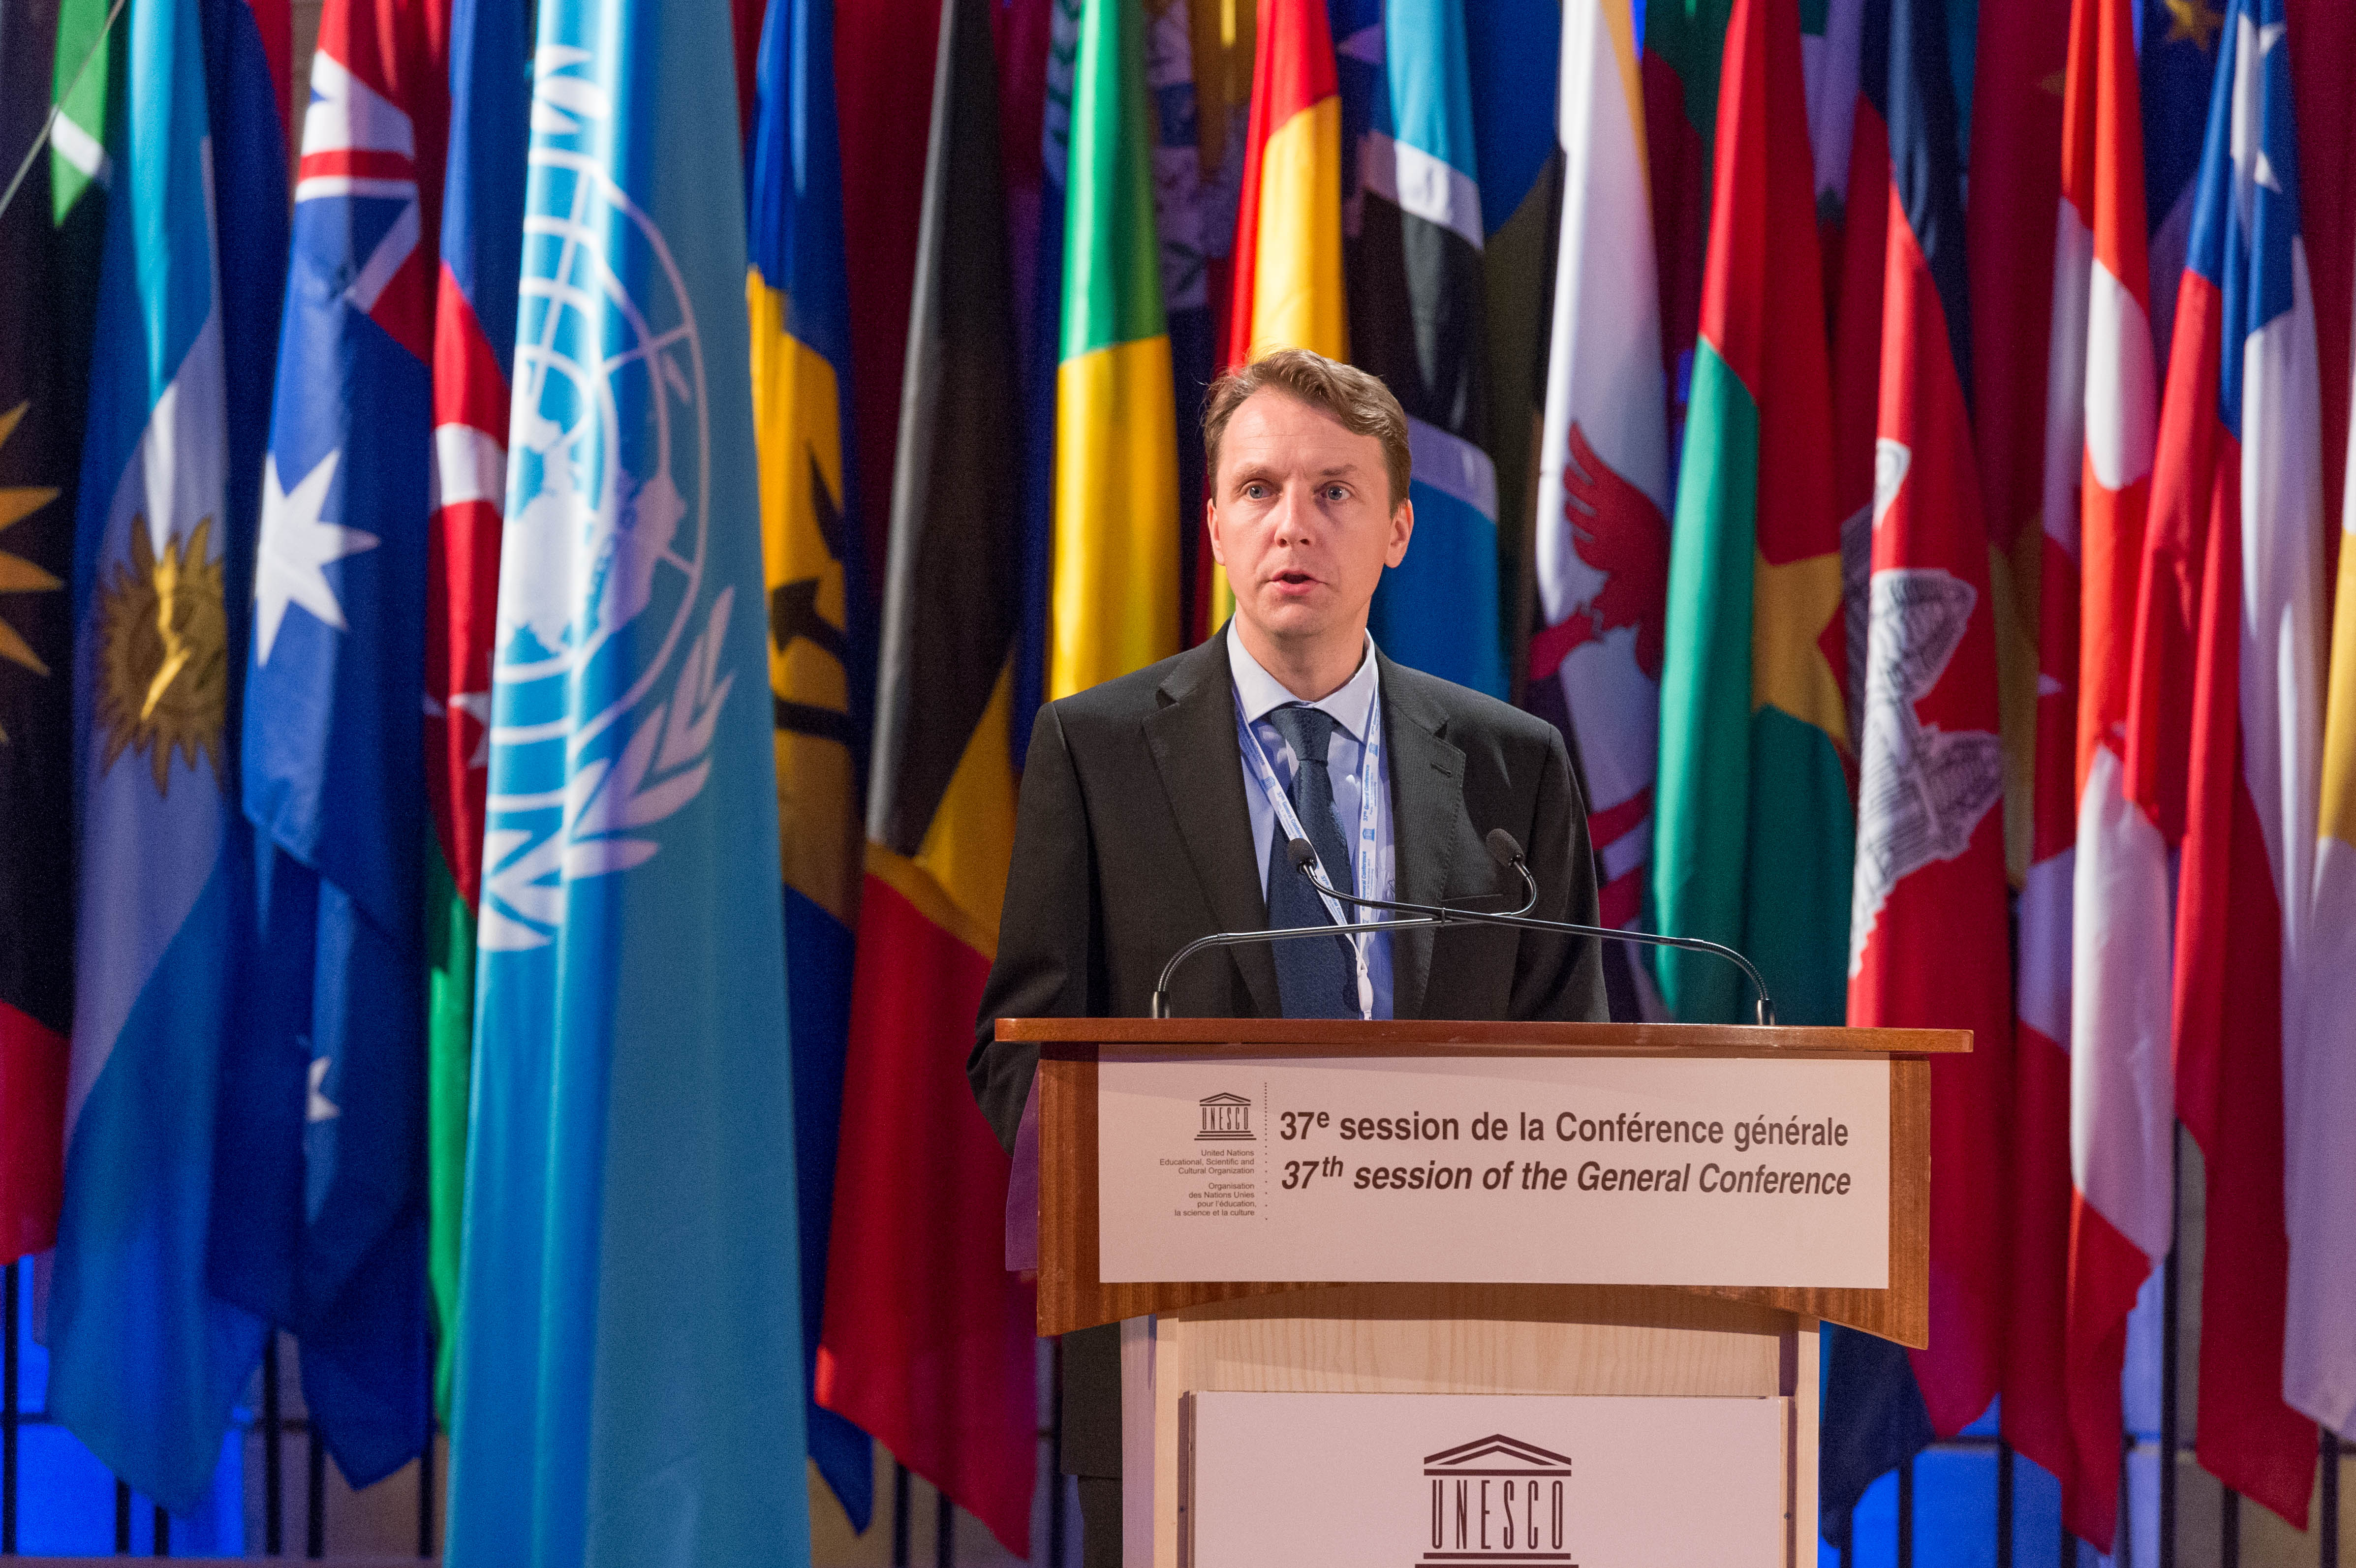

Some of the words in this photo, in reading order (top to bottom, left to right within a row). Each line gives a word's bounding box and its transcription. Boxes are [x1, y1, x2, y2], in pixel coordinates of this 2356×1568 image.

[1202, 1107, 1248, 1130] UNESCO
[1280, 1111, 1330, 1140] 37e
[1339, 1111, 1459, 1140] session
[1471, 1111, 1508, 1140] de
[1520, 1111, 1545, 1141] la
[1556, 1112, 1724, 1144] Conférence
[1734, 1114, 1849, 1152] générale
[1208, 1167, 1254, 1175] Organization
[1281, 1156, 1344, 1190] 37th
[1353, 1160, 1473, 1190] session
[1482, 1160, 1515, 1190] of
[1521, 1161, 1568, 1191] the
[1577, 1161, 1691, 1192] General
[1699, 1163, 1851, 1195] Conference
[1432, 1479, 1563, 1550] UNESCO
